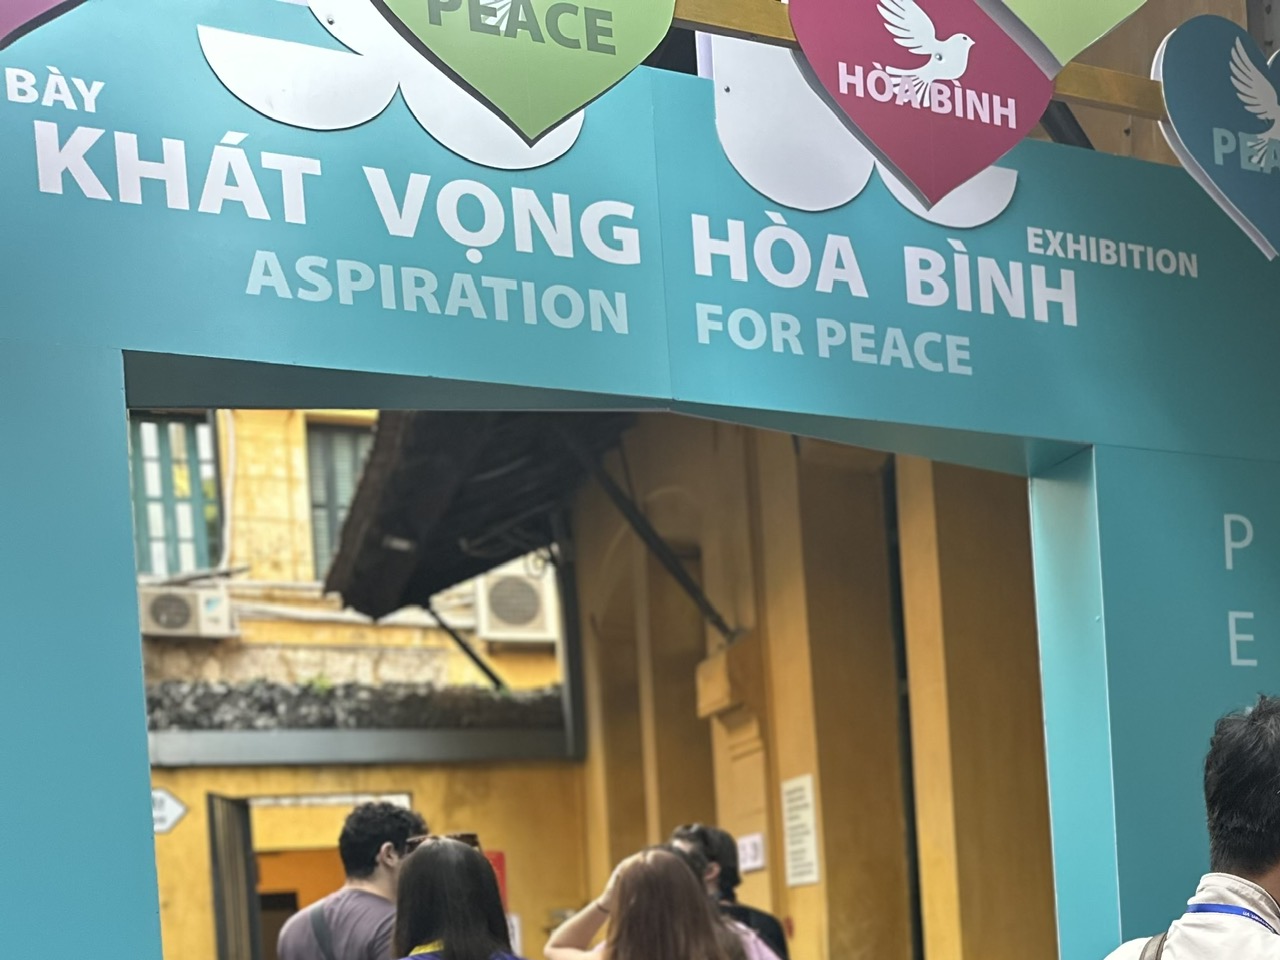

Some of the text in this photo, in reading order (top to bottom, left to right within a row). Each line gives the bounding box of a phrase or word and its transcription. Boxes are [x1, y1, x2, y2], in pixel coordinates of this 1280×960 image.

[4, 66, 105, 114] BÀY
[838, 61, 1017, 130] HÒA BÌNH
[34, 120, 1079, 327] KHÁT VỌNG HÒA BÌNH
[1026, 226, 1199, 279] EXHIBITION
[245, 250, 974, 378] ASPIRATION FOR PEACE
[1223, 513, 1258, 714] PE
